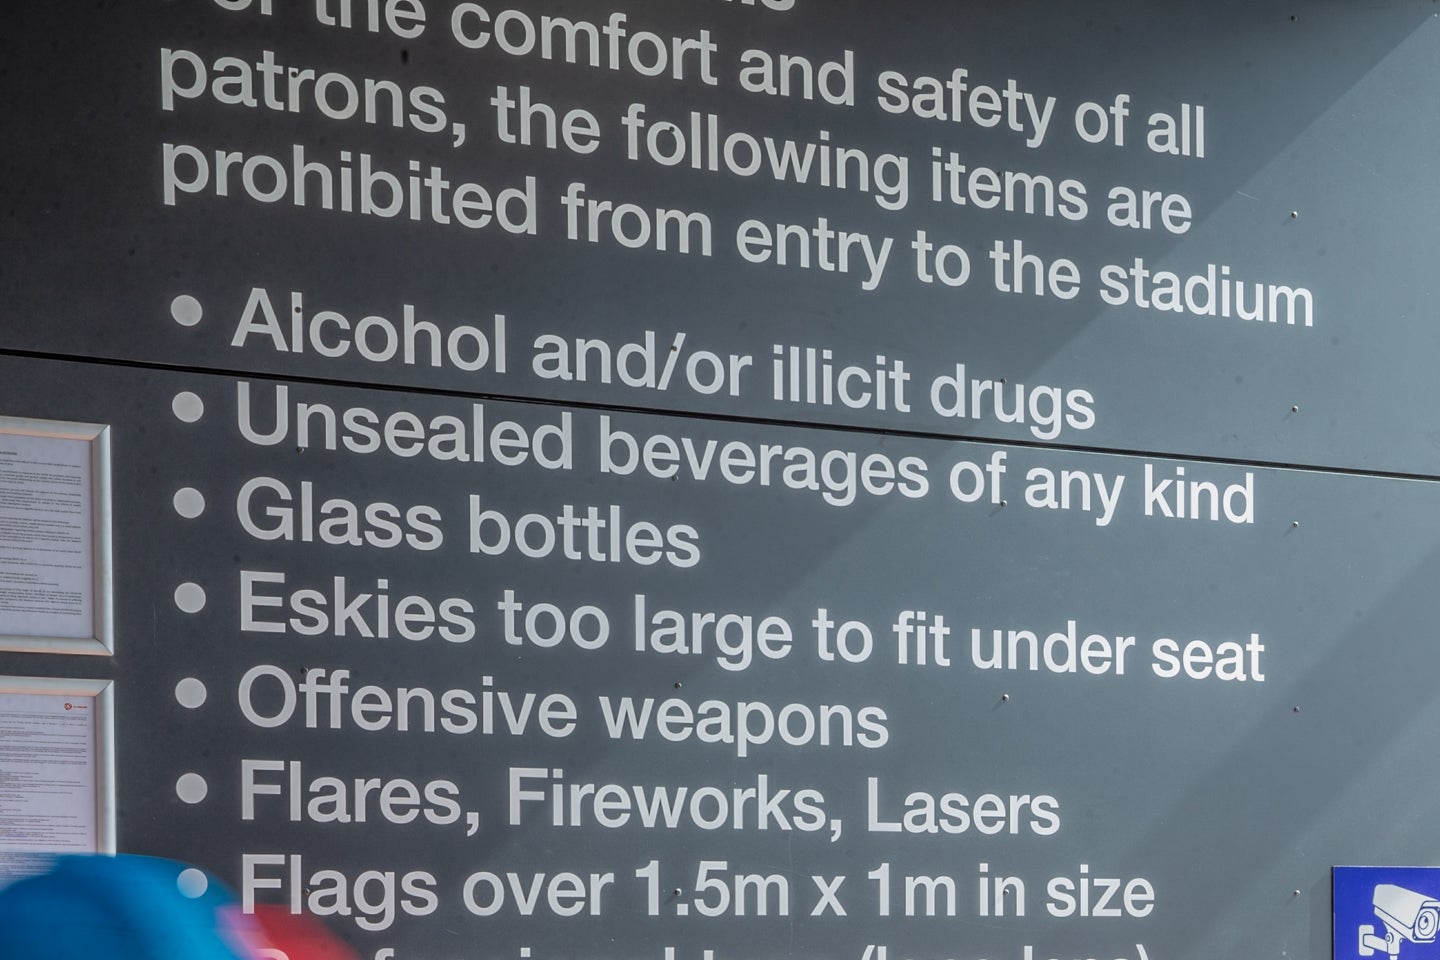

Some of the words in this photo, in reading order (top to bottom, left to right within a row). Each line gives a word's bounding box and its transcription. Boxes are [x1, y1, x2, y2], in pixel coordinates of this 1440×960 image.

[160, 47, 466, 148] patrons,
[490, 85, 601, 155] the
[620, 102, 910, 211] following
[932, 147, 1089, 221] items
[1106, 186, 1193, 235] are
[450, 2, 718, 86] comfort
[739, 48, 855, 107] and
[877, 68, 1057, 149] safety
[1074, 93, 1131, 147] of
[1146, 102, 1206, 159] all
[162, 142, 537, 236] prohibited
[560, 181, 712, 257] from
[736, 216, 894, 291] entry
[911, 229, 971, 287] to
[988, 239, 1081, 300] the
[1099, 257, 1314, 327] stadium
[230, 287, 506, 374] Alcohol
[532, 329, 753, 397] and/or
[773, 343, 911, 413] illicit
[930, 363, 1096, 441] drugs
[237, 380, 573, 470] Unsealed
[599, 414, 930, 507] beverages
[949, 450, 1008, 505] of
[1024, 467, 1126, 527] any
[1144, 463, 1255, 524] kind
[236, 476, 444, 551] Glass
[469, 494, 701, 568] bottles
[239, 569, 476, 644] Eskies
[497, 589, 610, 650] too
[634, 593, 793, 672] large
[811, 607, 874, 663] to
[892, 610, 951, 667] fit
[971, 619, 1136, 676] under
[1151, 633, 1266, 682] seat
[237, 664, 578, 738] Offensive
[598, 695, 889, 758] weapons
[241, 758, 480, 837] Flares,
[508, 766, 842, 843] Fireworks,
[867, 776, 1061, 836] Lasers
[241, 853, 439, 932] Flags
[462, 871, 615, 917] over
[635, 860, 789, 918] 1.5m
[810, 875, 848, 917] x
[867, 862, 957, 917] 1m
[979, 863, 1026, 917] in
[1046, 863, 1155, 918] size
